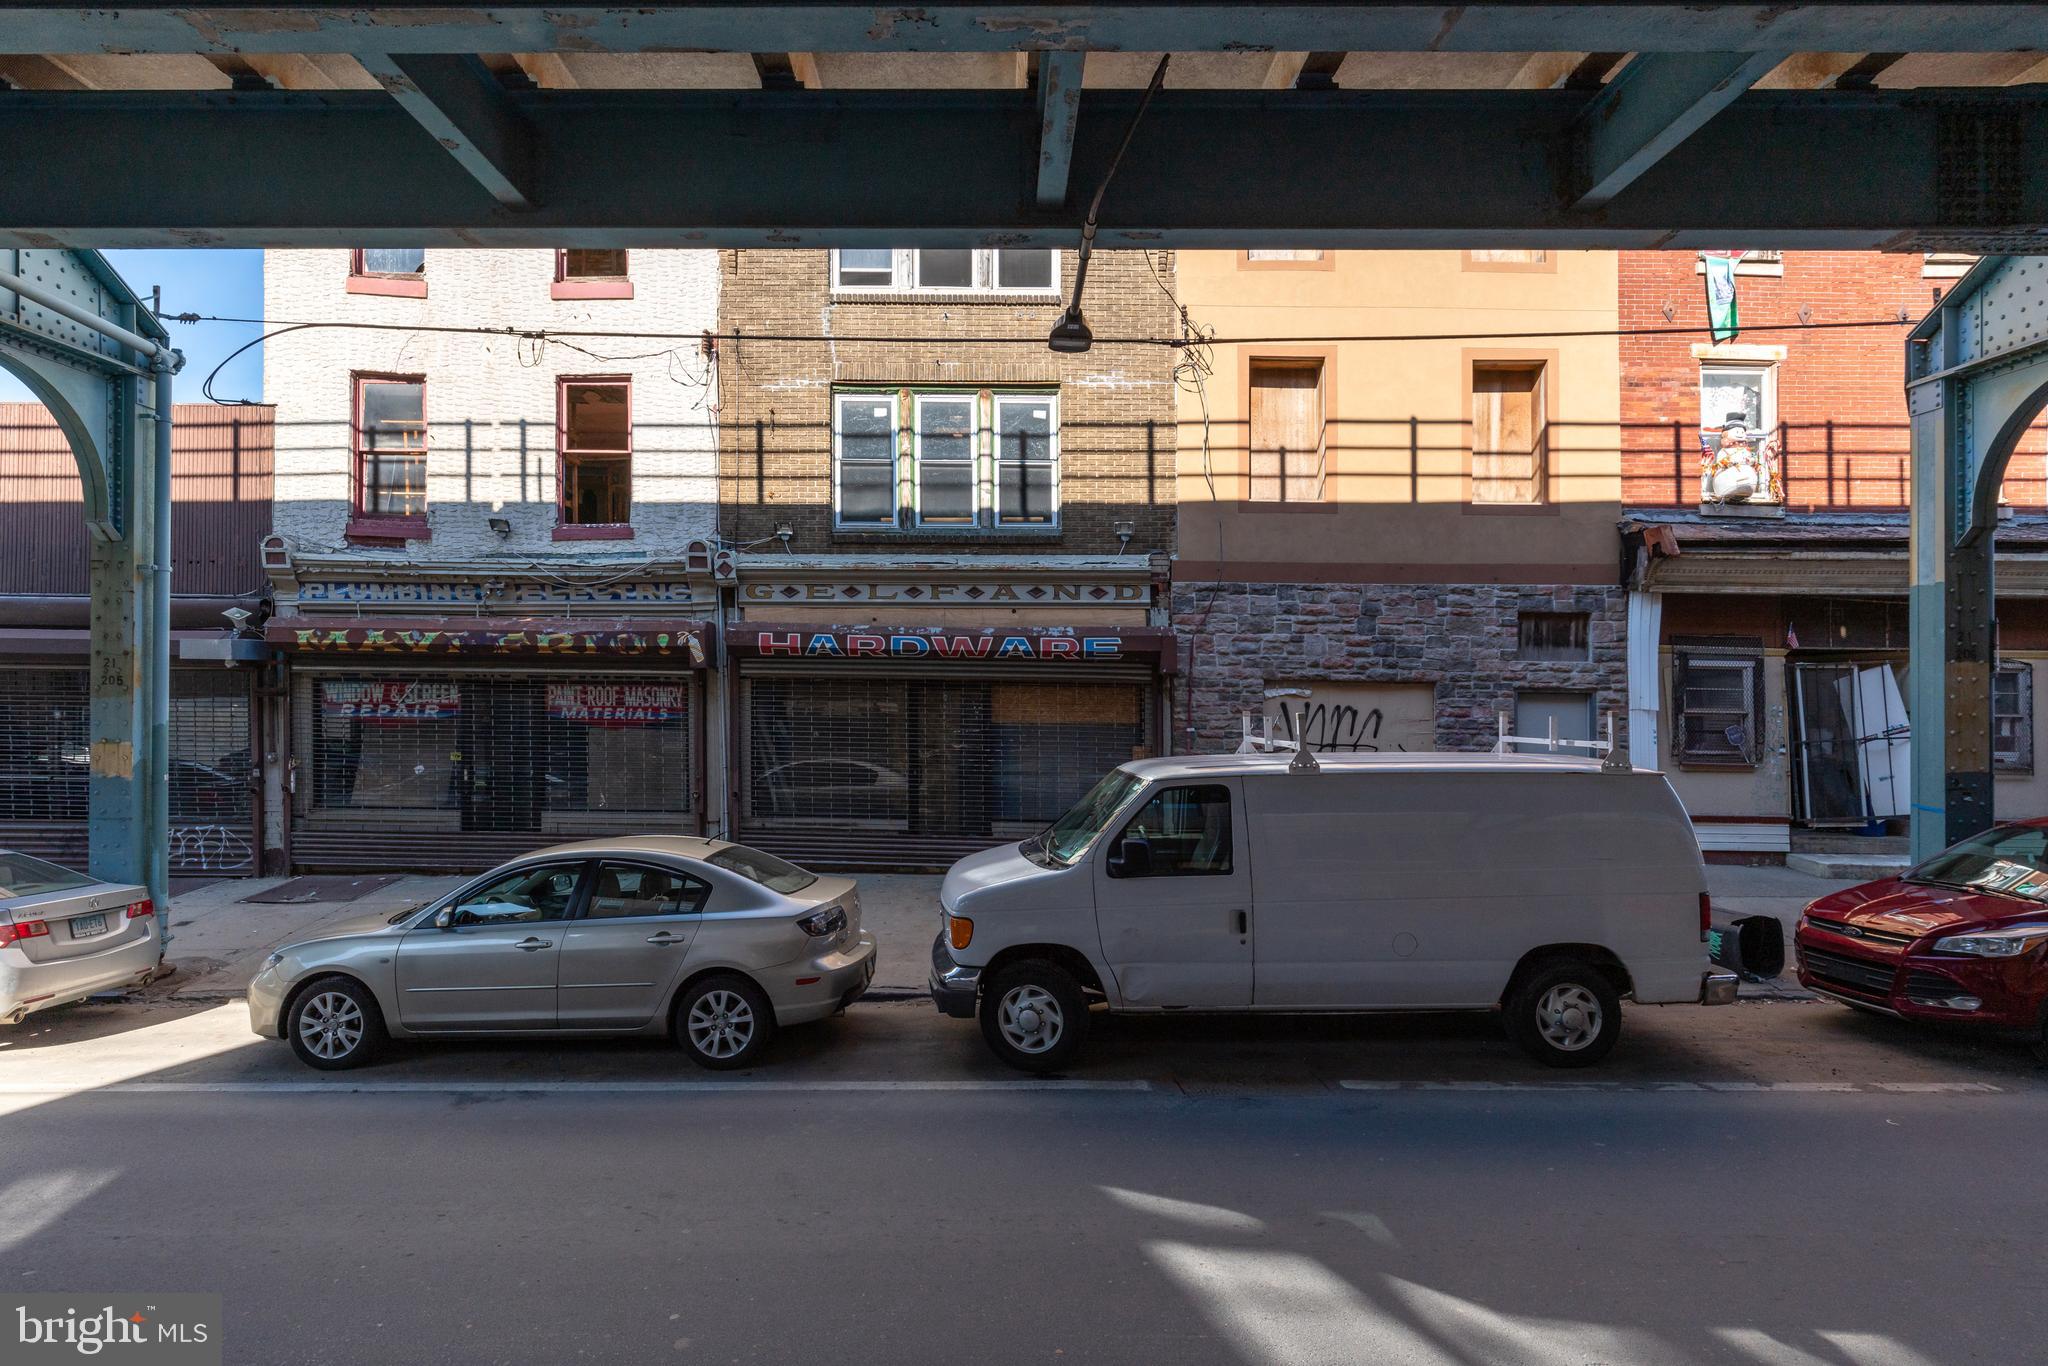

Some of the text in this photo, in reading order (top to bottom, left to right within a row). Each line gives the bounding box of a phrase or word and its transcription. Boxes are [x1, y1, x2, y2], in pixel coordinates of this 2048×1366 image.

[304, 583, 477, 601] PLUMBING
[758, 632, 1123, 660] HARDWARE
[103, 657, 116, 668] 21
[100, 675, 124, 686] 205
[324, 682, 459, 704] WINDOW & SCREEN
[340, 703, 440, 718] REPAIR
[560, 708, 669, 720] MATERIALS
